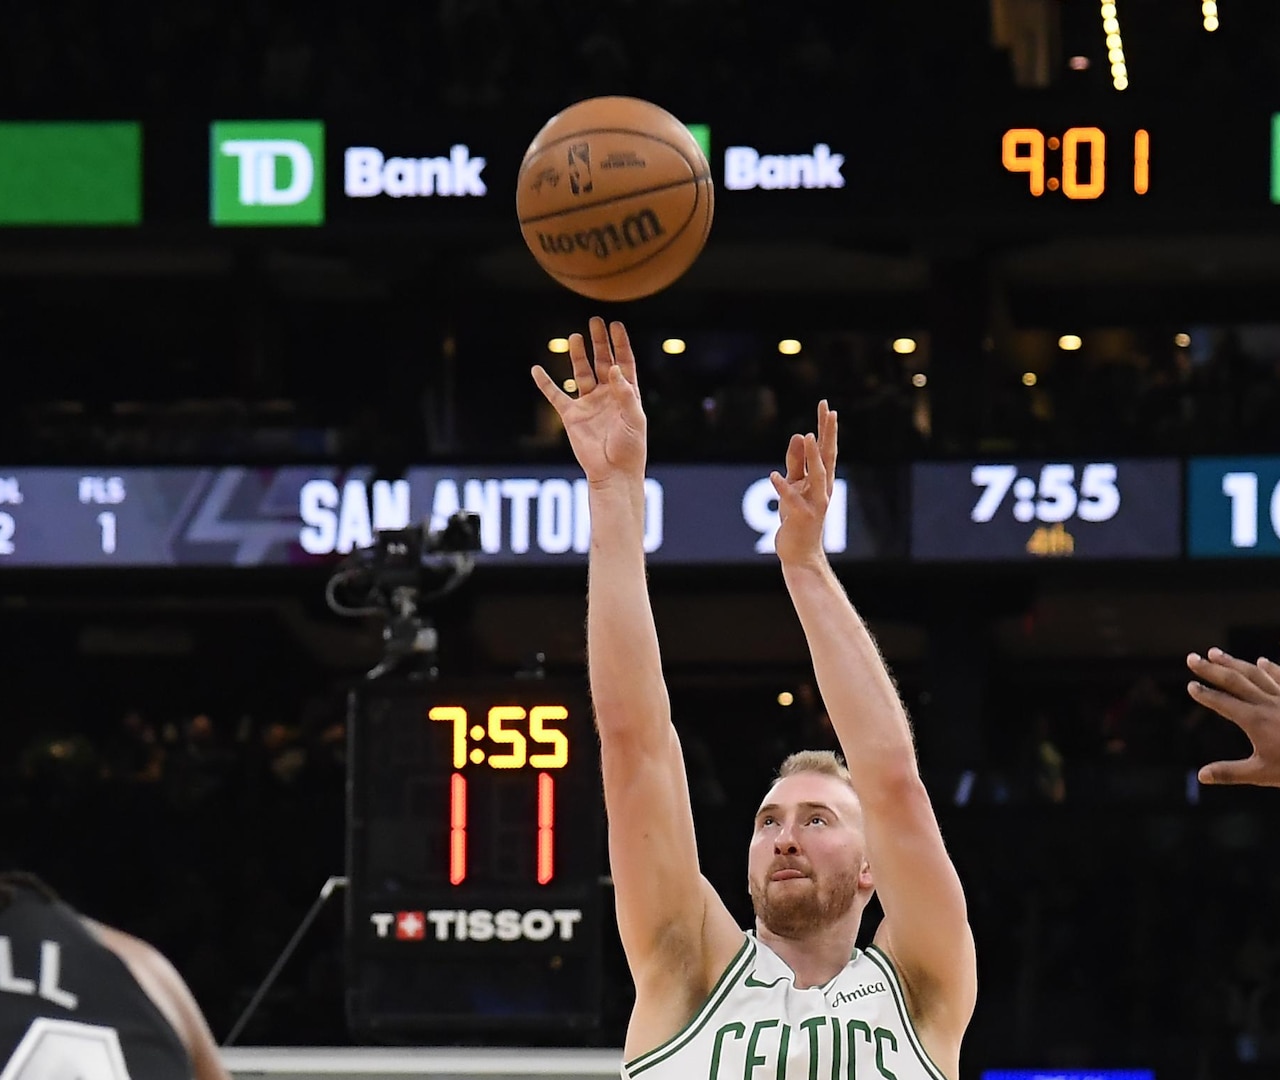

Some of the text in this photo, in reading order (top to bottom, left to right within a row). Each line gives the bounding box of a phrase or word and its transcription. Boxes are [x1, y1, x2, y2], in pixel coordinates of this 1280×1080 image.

[220, 140, 314, 206] TD
[344, 145, 486, 198] Bank
[724, 144, 844, 190] Bank
[1001, 126, 1150, 200] 9:01
[537, 207, 666, 261] Wilson
[77, 475, 127, 505] FLS
[299, 478, 411, 554] SAN
[972, 464, 1120, 523] 7:55
[97, 510, 117, 555] 1
[428, 705, 569, 769] 7:55
[450, 772, 554, 885] 11
[427, 909, 582, 941] TISSOT
[831, 979, 887, 1008] Amica
